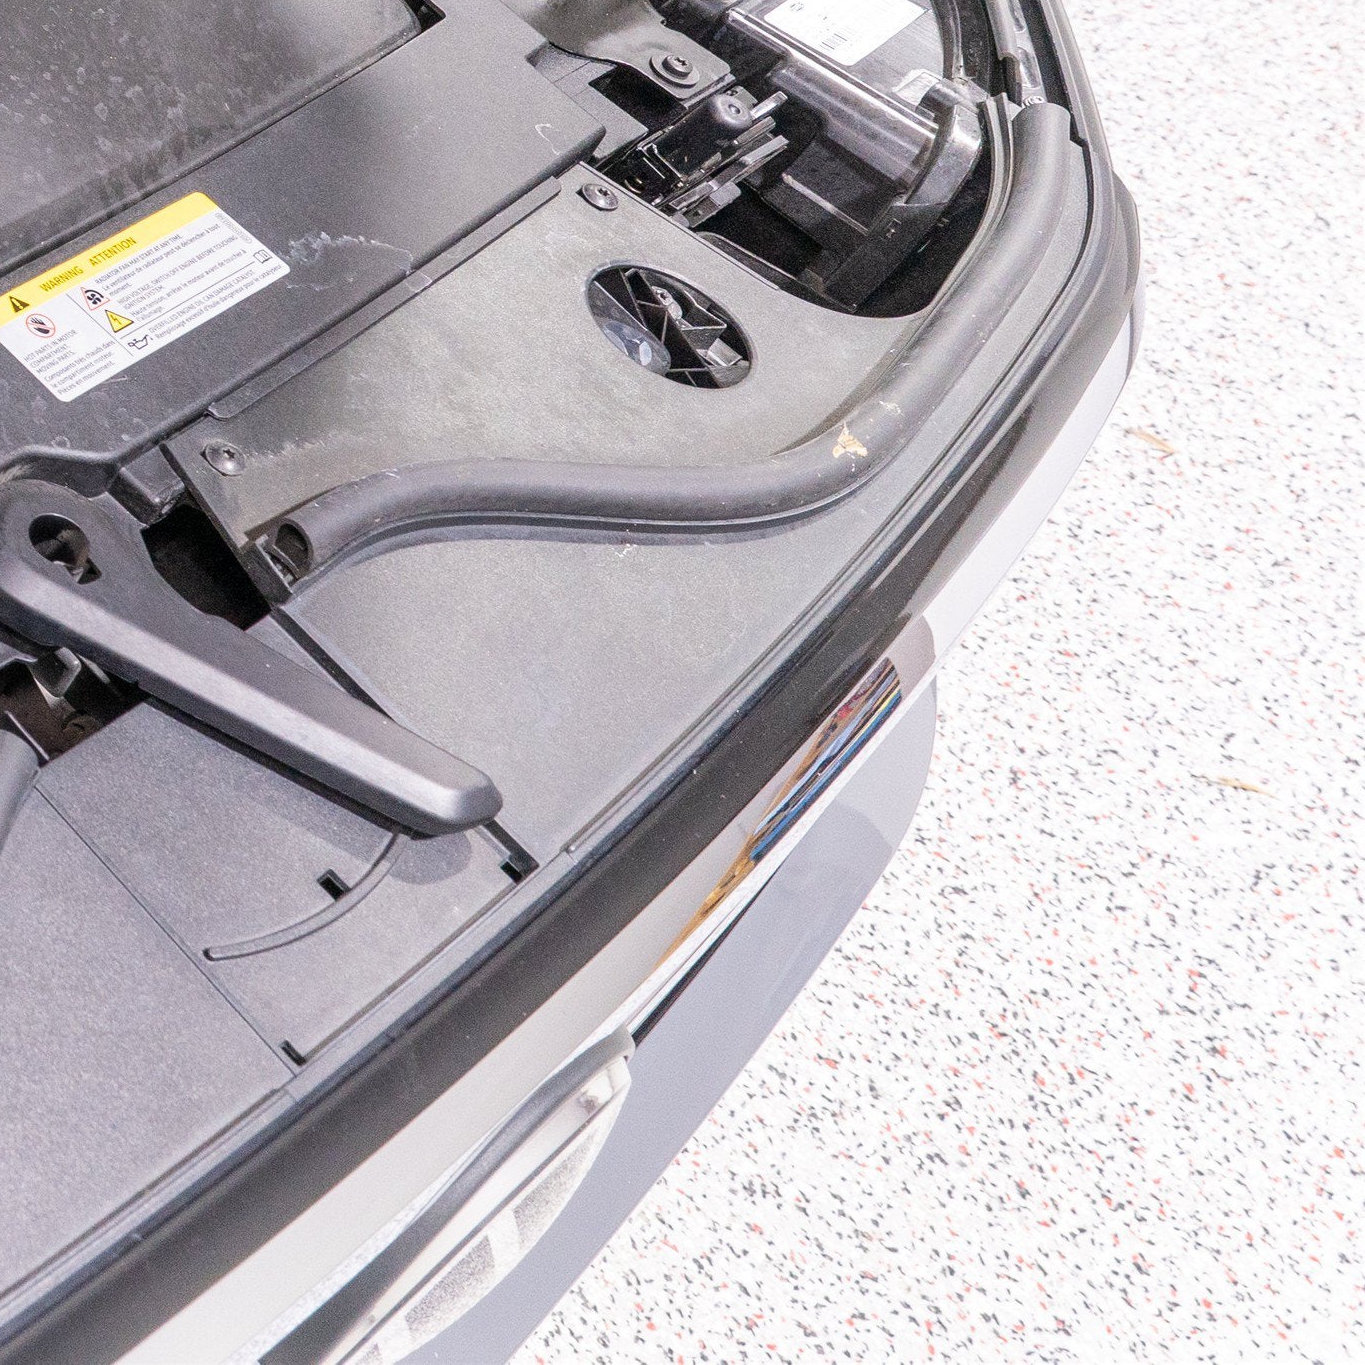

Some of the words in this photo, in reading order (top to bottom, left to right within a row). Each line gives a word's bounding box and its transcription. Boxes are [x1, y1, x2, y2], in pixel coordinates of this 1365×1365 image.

[38, 264, 84, 292] WARNING
[87, 235, 139, 266] ATTENTION
[100, 283, 111, 291] Le
[107, 269, 137, 287] ventilateur
[133, 265, 143, 273] de
[140, 253, 164, 269] radiateur
[161, 247, 177, 258] peut
[207, 223, 220, 232] tout
[117, 262, 130, 271] FAN
[127, 256, 141, 265] MAY
[137, 248, 155, 260] START
[157, 239, 171, 248] ANY
[150, 272, 171, 285] SWITCH
[168, 266, 180, 275] OFF
[177, 257, 198, 270] ENGINE
[195, 247, 215, 260] BEFORE
[176, 303, 196, 316] ENGINE
[201, 292, 215, 302] CAN
[211, 281, 234, 296] DAMAGE
[22, 352, 37, 362] HOT
[33, 343, 53, 355] PARTS
[56, 329, 78, 343] MOTOR
[43, 361, 77, 383] Composants
[100, 338, 115, 349] dans
[35, 358, 59, 374] MOVING
